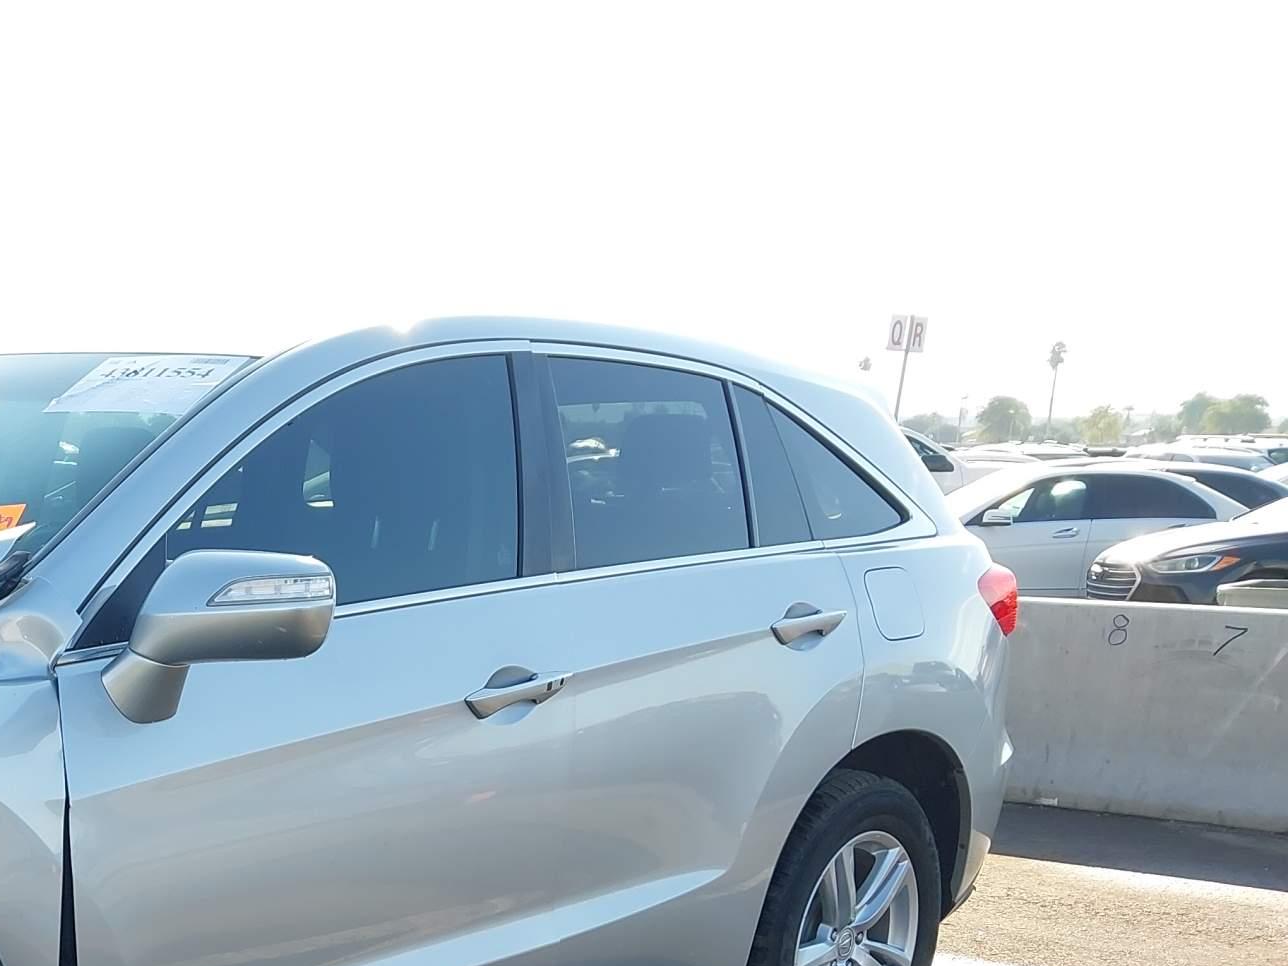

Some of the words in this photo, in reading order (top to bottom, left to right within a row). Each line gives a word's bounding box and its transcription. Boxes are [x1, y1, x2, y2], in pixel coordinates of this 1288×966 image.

[891, 319, 903, 346] Q
[912, 321, 924, 347] R
[98, 366, 216, 379] 43811554
[1108, 614, 1130, 646] 8
[1213, 625, 1249, 656] 7
